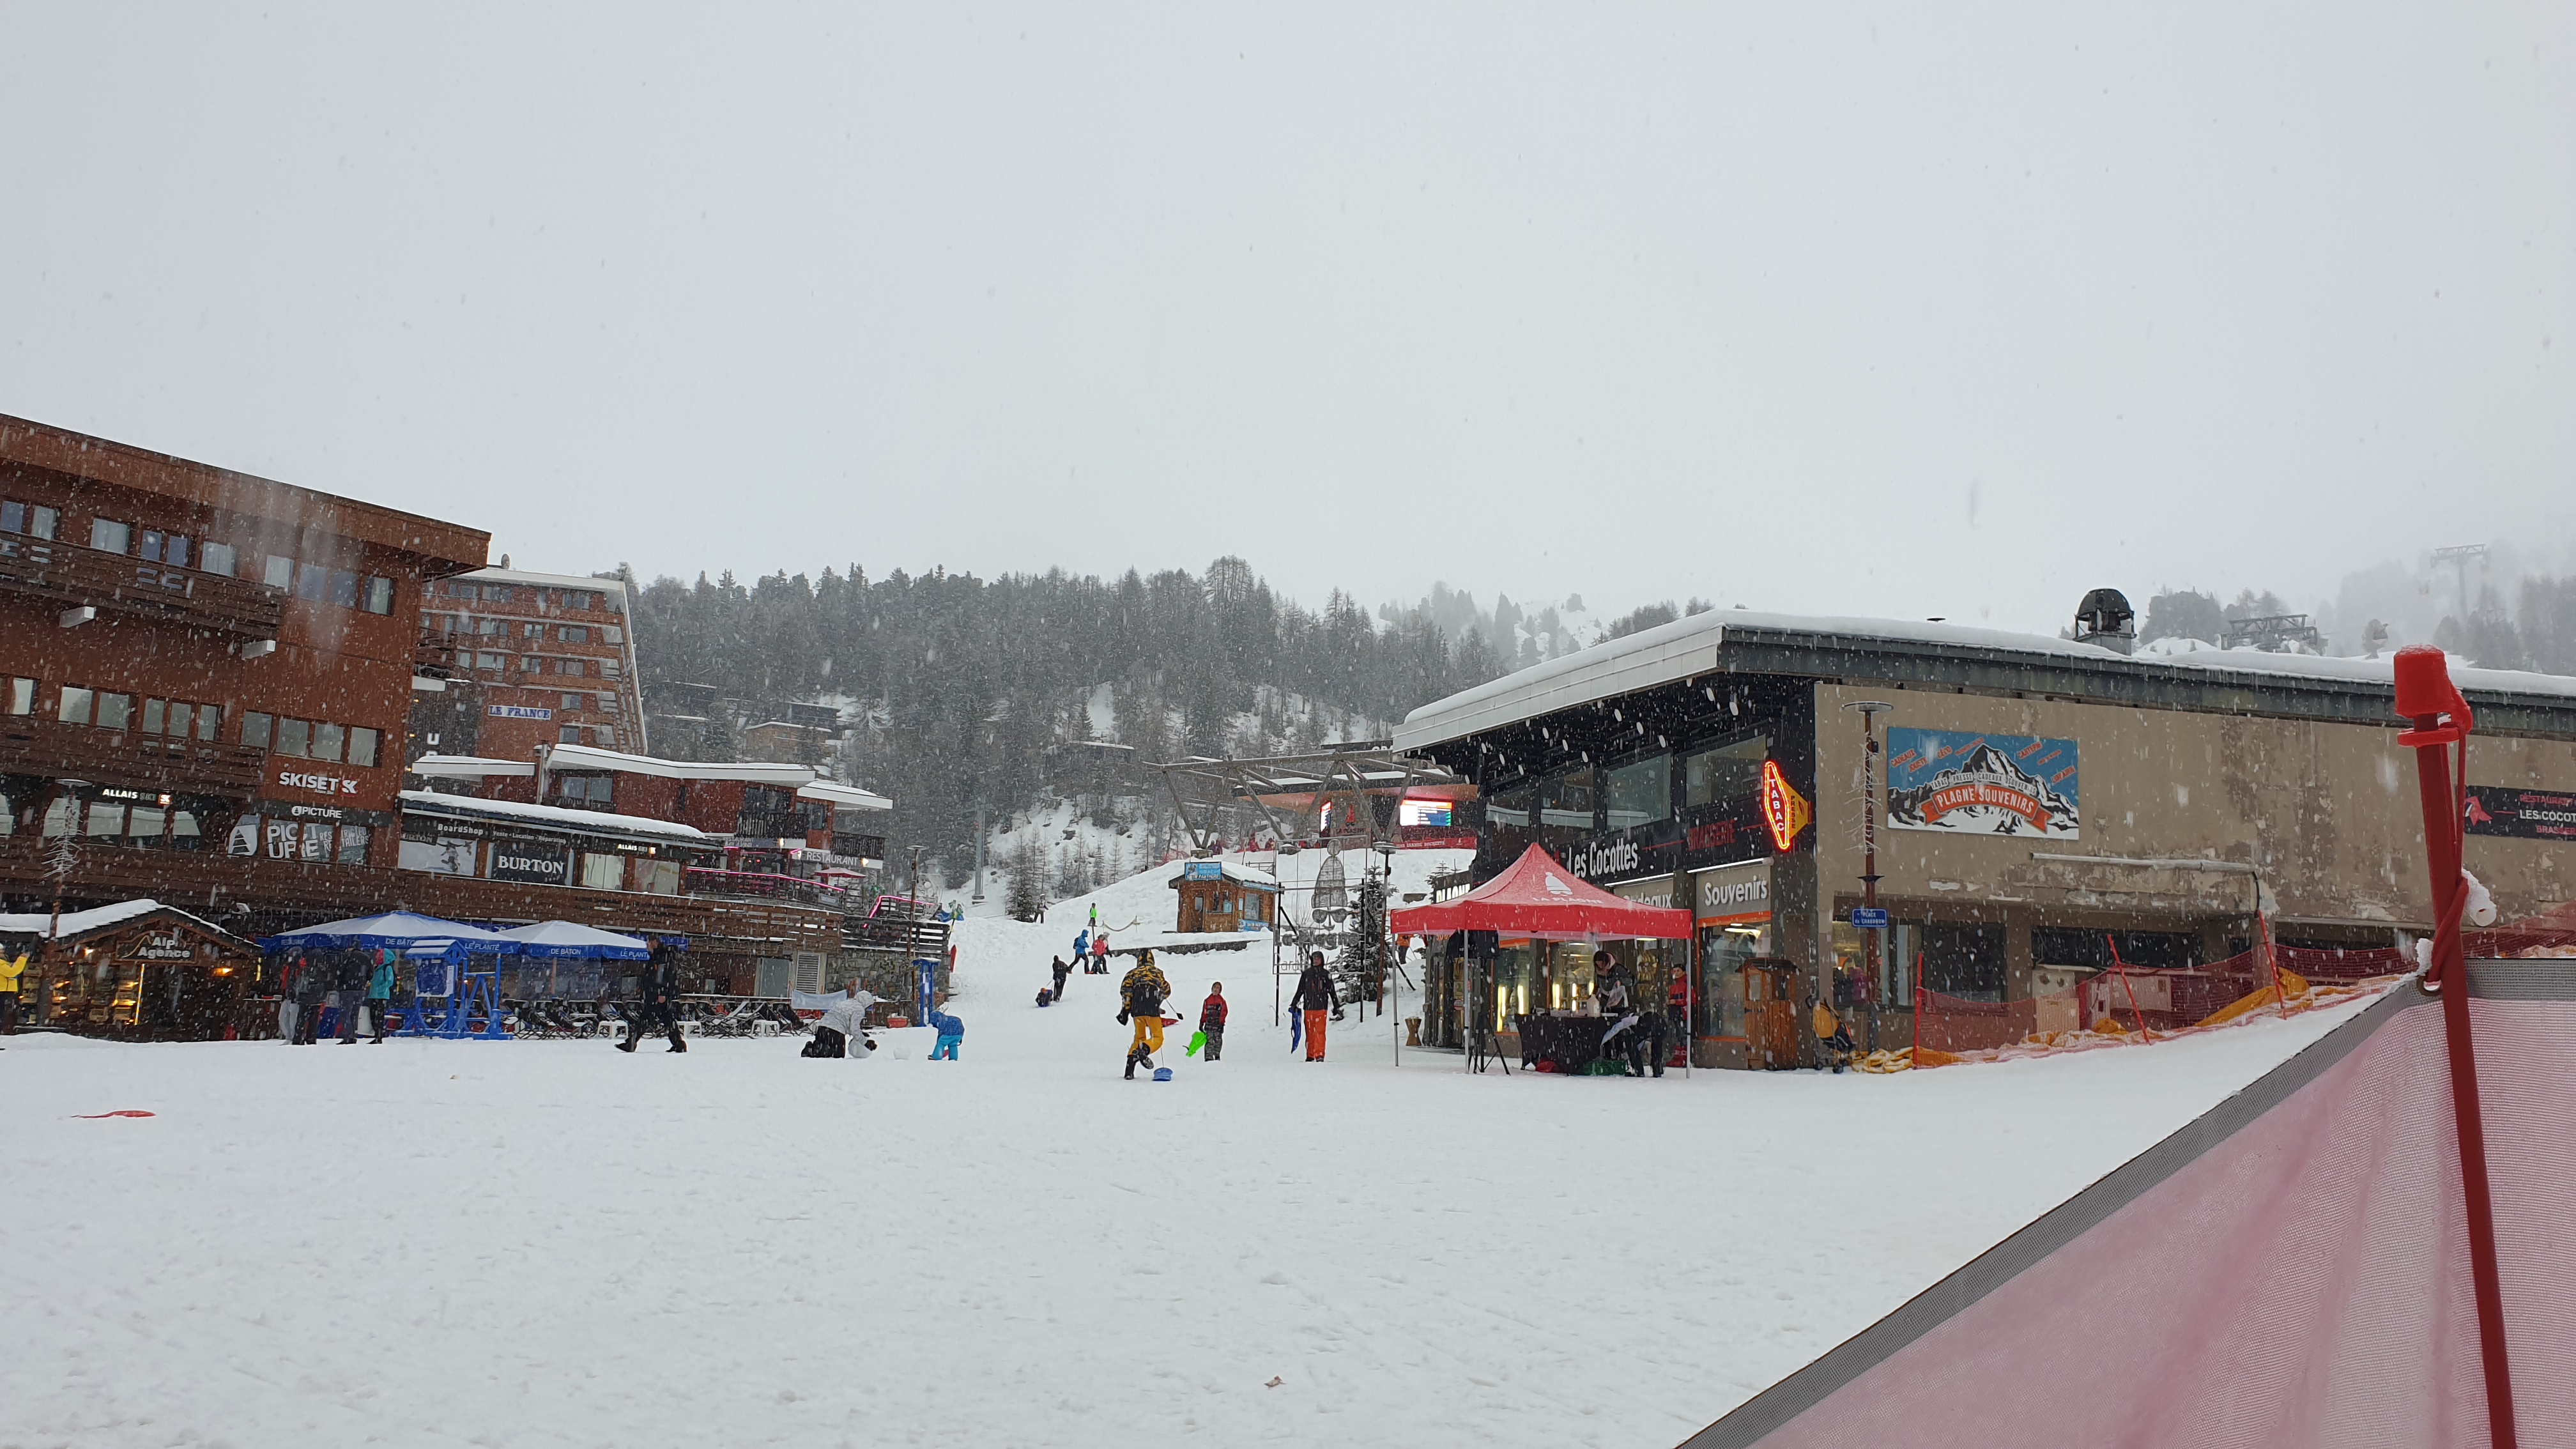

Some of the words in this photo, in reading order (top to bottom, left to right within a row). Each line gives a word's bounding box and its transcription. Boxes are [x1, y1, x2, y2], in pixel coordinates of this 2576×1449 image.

[489, 706, 502, 715] LE
[507, 707, 550, 718] FRANCE
[279, 772, 340, 791] SKISET
[1931, 778, 1948, 790] TABAC
[1953, 773, 1973, 782] PRESSE
[1978, 772, 2002, 782] CADEAUX
[102, 788, 138, 799] ALLAIS
[140, 793, 157, 801] SKI
[1936, 788, 1975, 808] PLAGNE
[1979, 788, 2034, 813] SOUVENIRS
[302, 806, 342, 818] PICTURE
[1769, 779, 1784, 831] TABAC
[2519, 809, 2539, 820] LES
[438, 824, 484, 836] BoardShop
[806, 852, 859, 866] RESTAURANT
[1590, 837, 1638, 876] Cocottes
[498, 855, 564, 874] BURTON
[1705, 875, 1768, 907] Souvenirs
[151, 937, 175, 949] Alp
[137, 947, 190, 959] Agence
